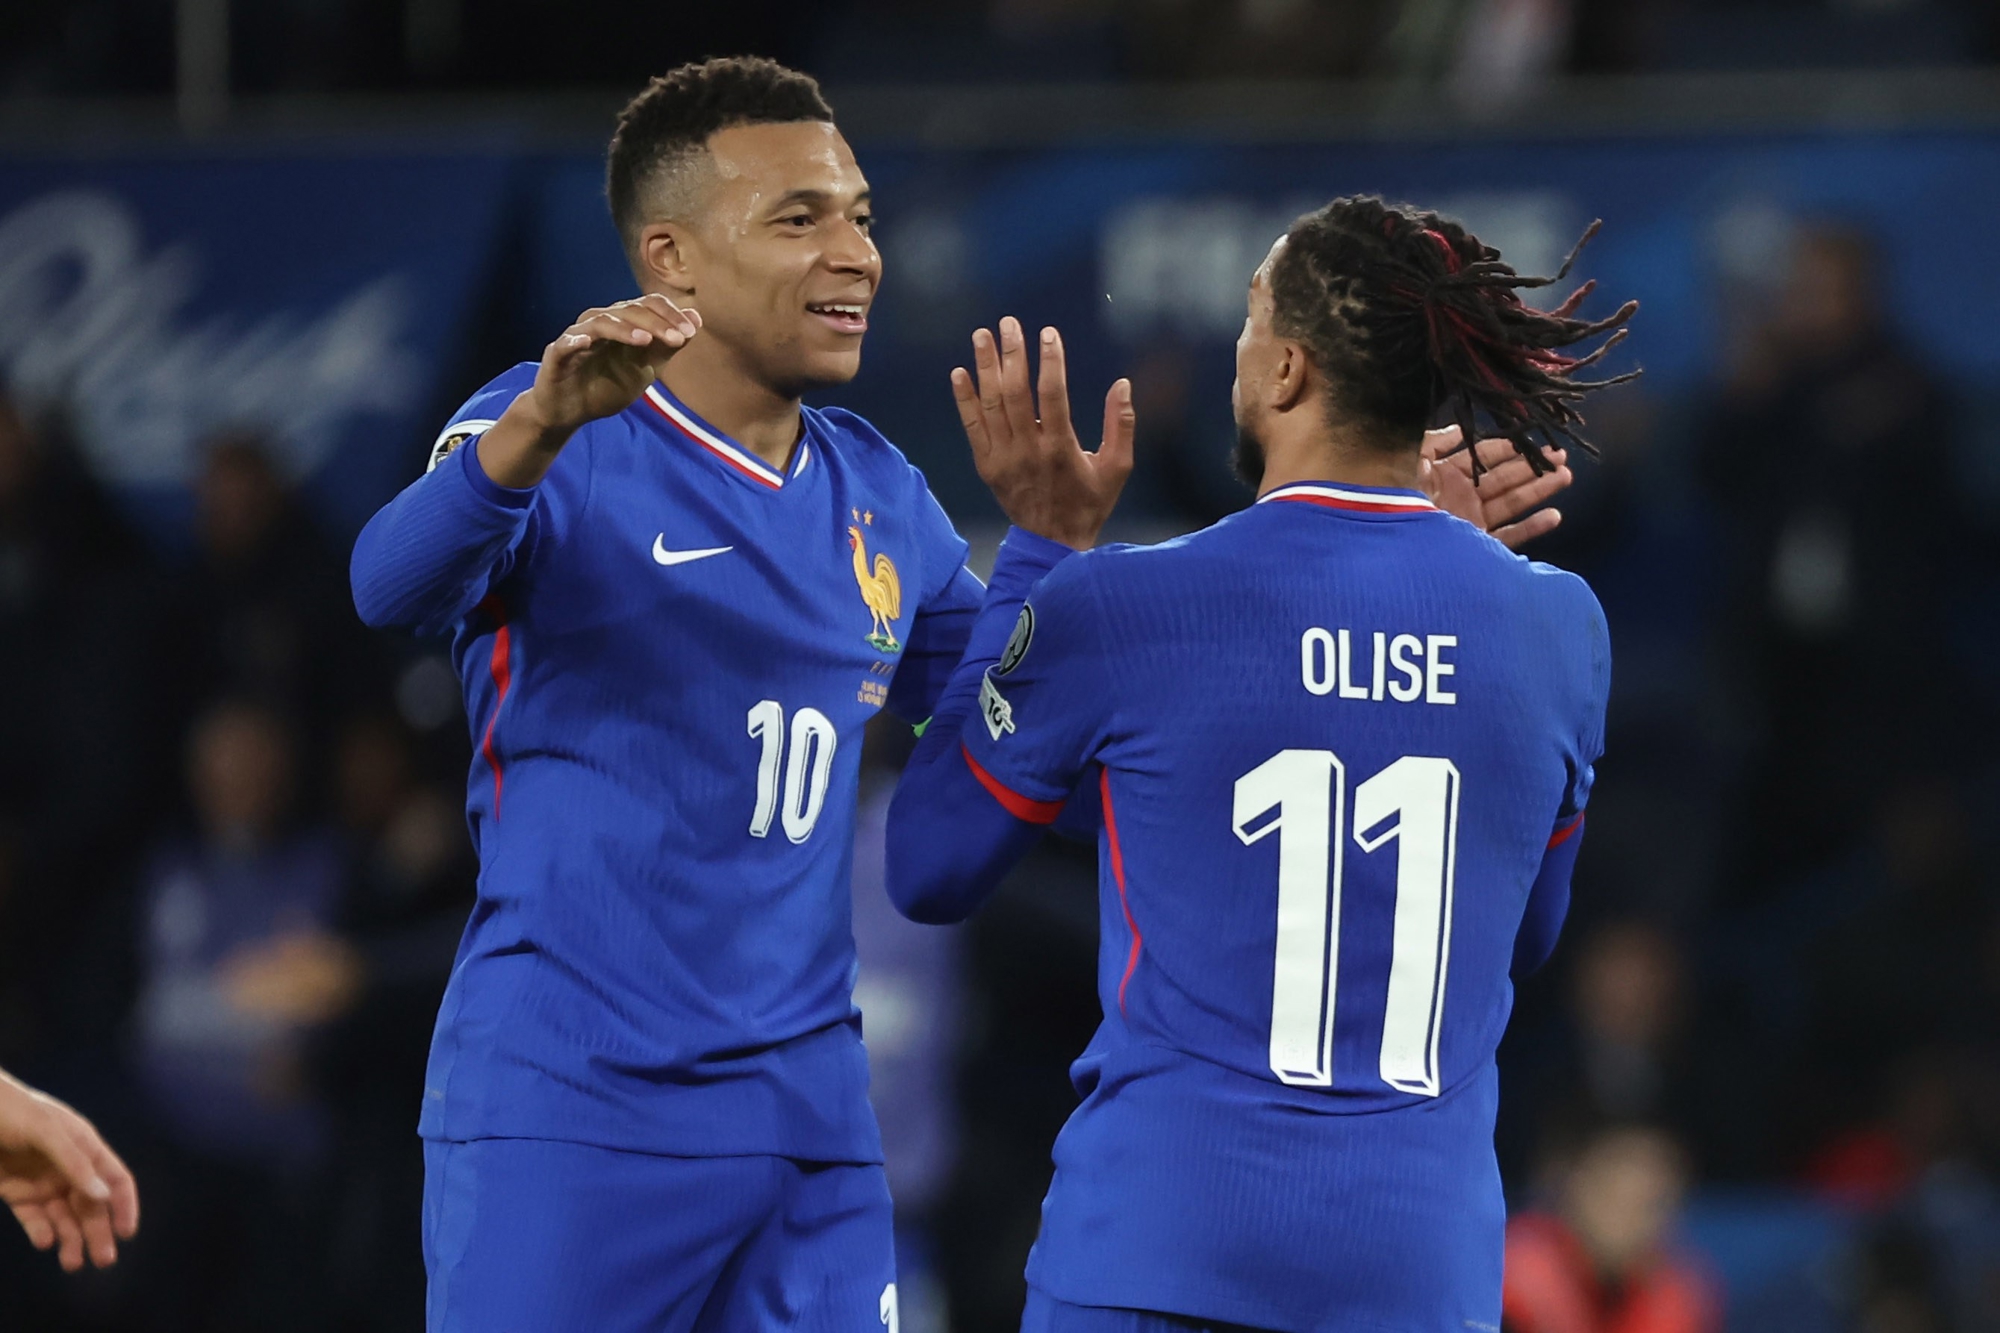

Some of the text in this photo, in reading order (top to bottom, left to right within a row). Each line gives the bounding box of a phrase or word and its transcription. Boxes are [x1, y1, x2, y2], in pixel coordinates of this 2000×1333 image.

[1302, 627, 1457, 704] OLISE
[748, 700, 837, 844] 10
[1232, 749, 1460, 1097] 11
